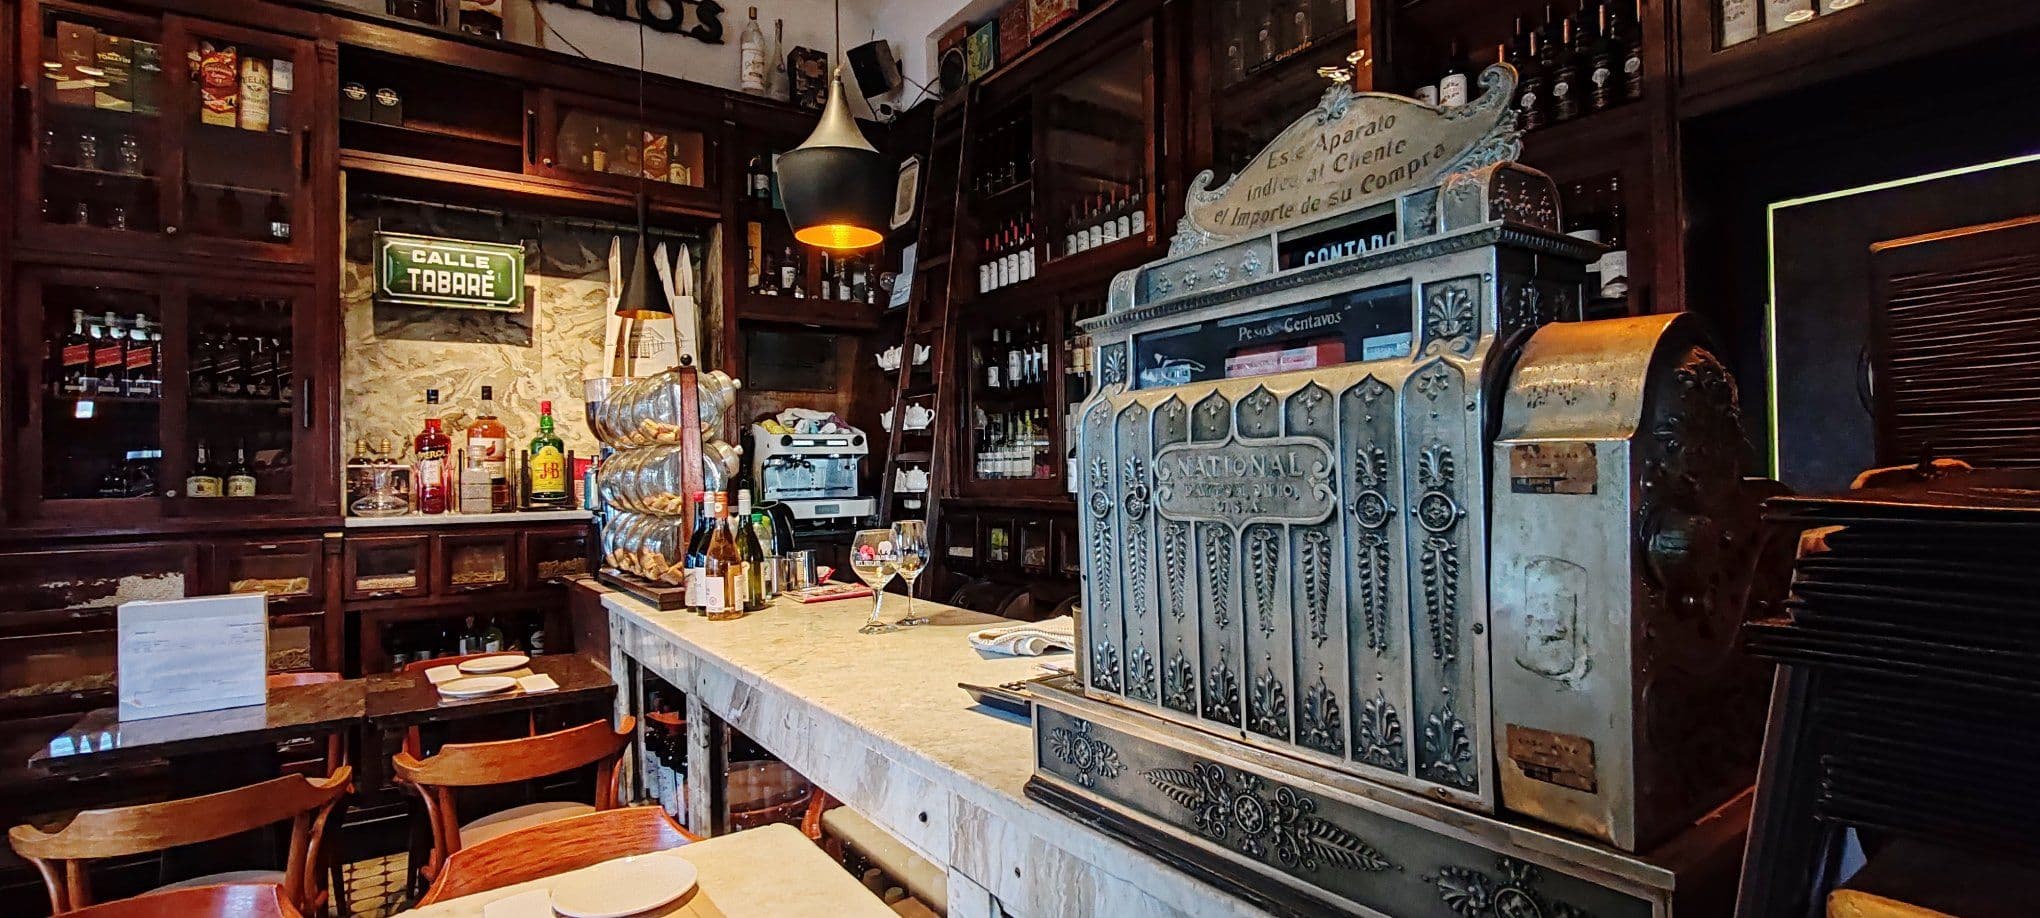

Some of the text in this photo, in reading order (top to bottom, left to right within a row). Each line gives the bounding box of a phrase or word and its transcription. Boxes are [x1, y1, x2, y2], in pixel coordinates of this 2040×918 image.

[1317, 114, 1396, 154] Aparato
[1214, 143, 1446, 230] el Importe de su Compra
[412, 249, 490, 269] CALLE
[407, 268, 495, 297] TABARÉ
[1238, 311, 1343, 341] Pesos Centavos
[1177, 451, 1304, 478] NATIONAL
